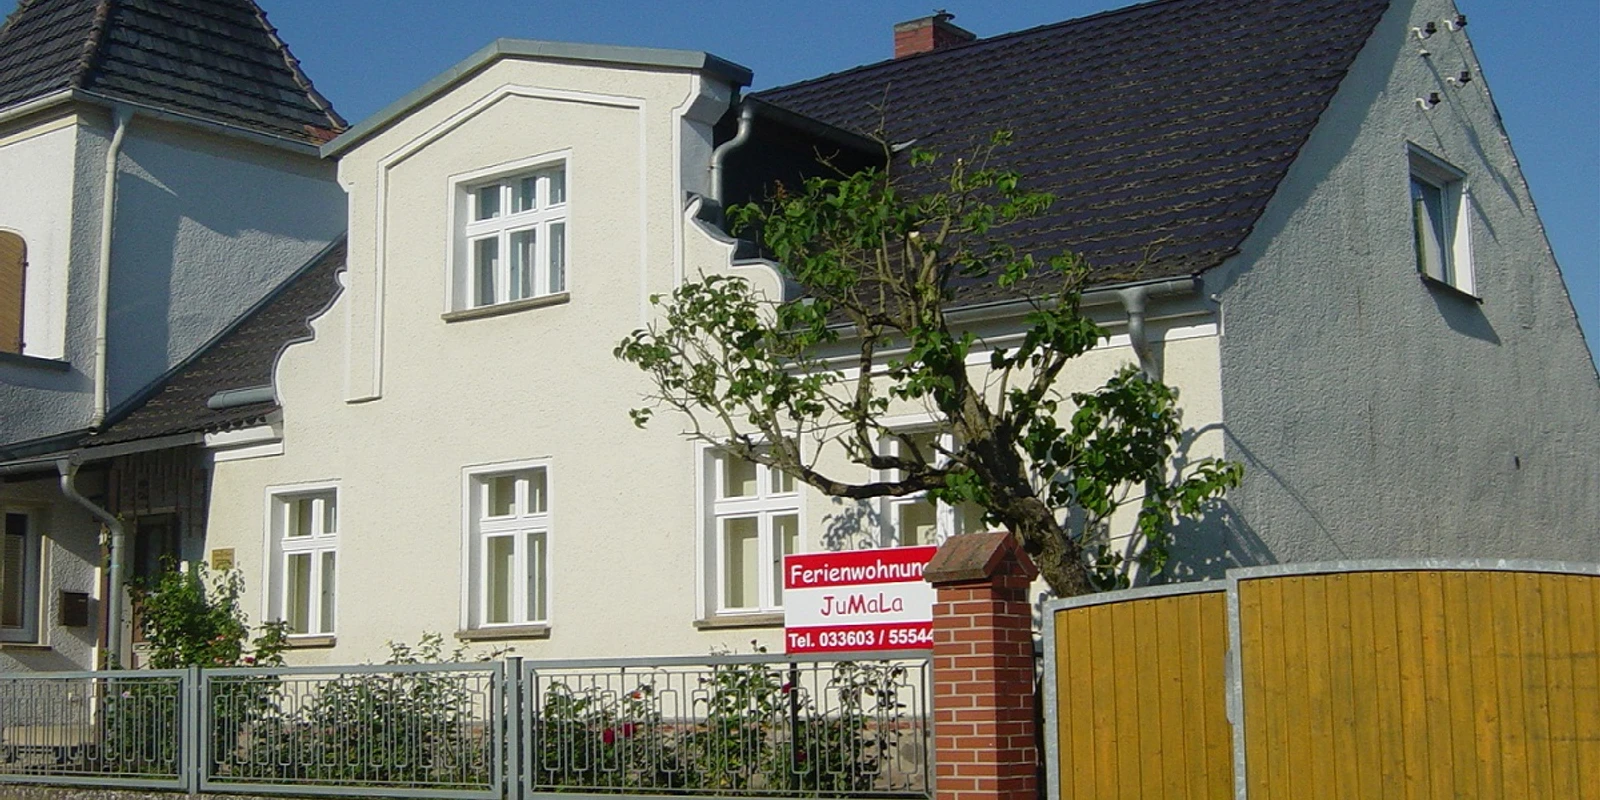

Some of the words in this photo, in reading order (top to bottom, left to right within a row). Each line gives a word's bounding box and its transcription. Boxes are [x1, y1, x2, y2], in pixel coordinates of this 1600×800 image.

[820, 592, 904, 617] JuMaLa
[788, 632, 816, 648] Tel.
[818, 631, 875, 648] 033603
[878, 629, 885, 645] /
[888, 628, 934, 645] 55544
